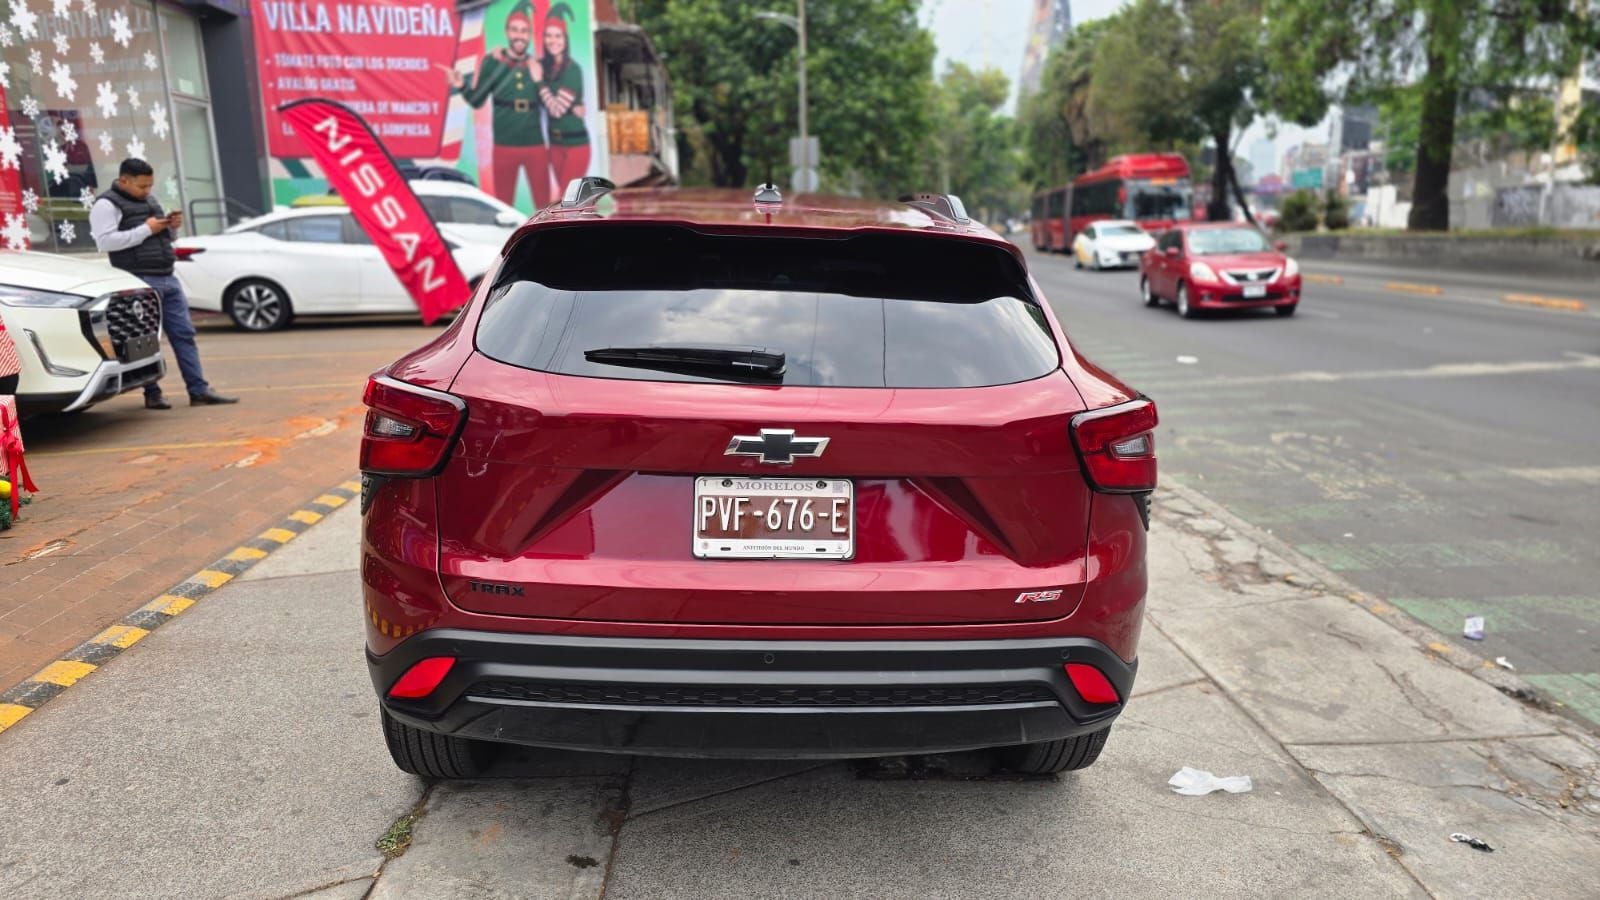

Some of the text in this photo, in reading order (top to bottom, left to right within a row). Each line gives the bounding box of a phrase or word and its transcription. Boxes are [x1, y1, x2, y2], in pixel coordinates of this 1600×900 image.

[262, 1, 454, 37] VILLA NAVIDEÑA
[343, 56, 364, 69] CON
[366, 57, 384, 69] LOS
[386, 57, 429, 70] DUENDES
[320, 78, 357, 91] GRATIS
[377, 101, 389, 114] DE
[433, 102, 439, 115] Y
[382, 123, 431, 136] SORPRESA
[314, 116, 448, 294] NISSAN
[735, 481, 814, 491] MORELOS
[701, 497, 847, 532] PVF-676-E
[468, 580, 525, 597] TRAX
[1015, 589, 1063, 603] RS
